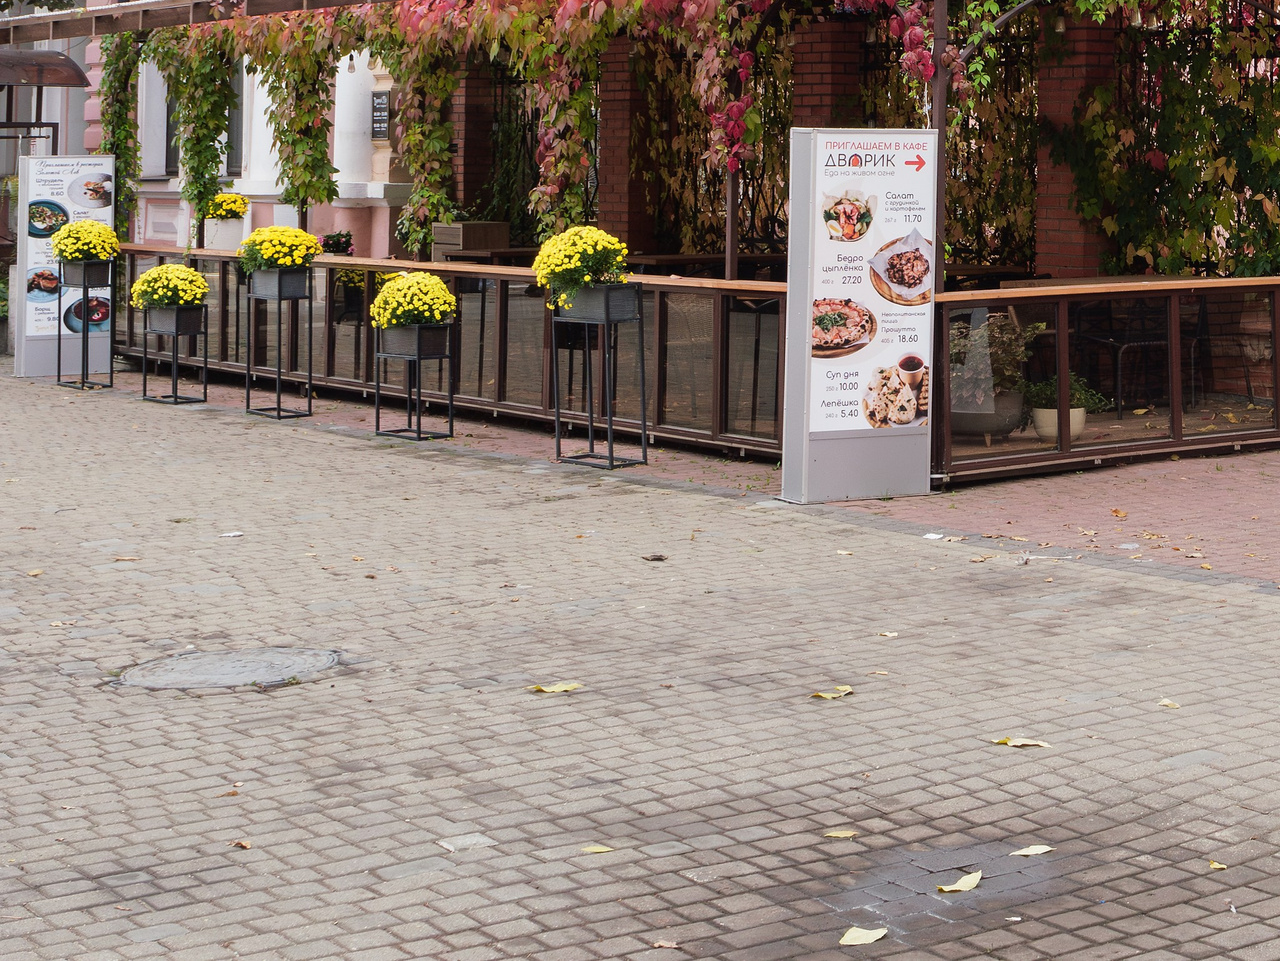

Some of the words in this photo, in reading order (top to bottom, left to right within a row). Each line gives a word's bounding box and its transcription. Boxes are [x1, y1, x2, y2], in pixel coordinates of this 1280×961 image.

[825, 141, 892, 151] ПРИГЛАШАЕМ
[894, 142, 900, 150] В
[902, 142, 928, 151] КАФЕ
[824, 169, 839, 178] Еда
[885, 191, 914, 200] Салат
[904, 214, 922, 223] 11.70
[837, 254, 863, 264] Бедро
[822, 264, 864, 273] цыплёнка
[842, 276, 862, 285] 27.20
[898, 334, 919, 343] 18.60
[826, 370, 841, 380] Суп
[843, 371, 859, 379] дня
[839, 382, 859, 391] 10.00
[821, 399, 859, 408] Лепёшка
[840, 409, 859, 418] 5.40
